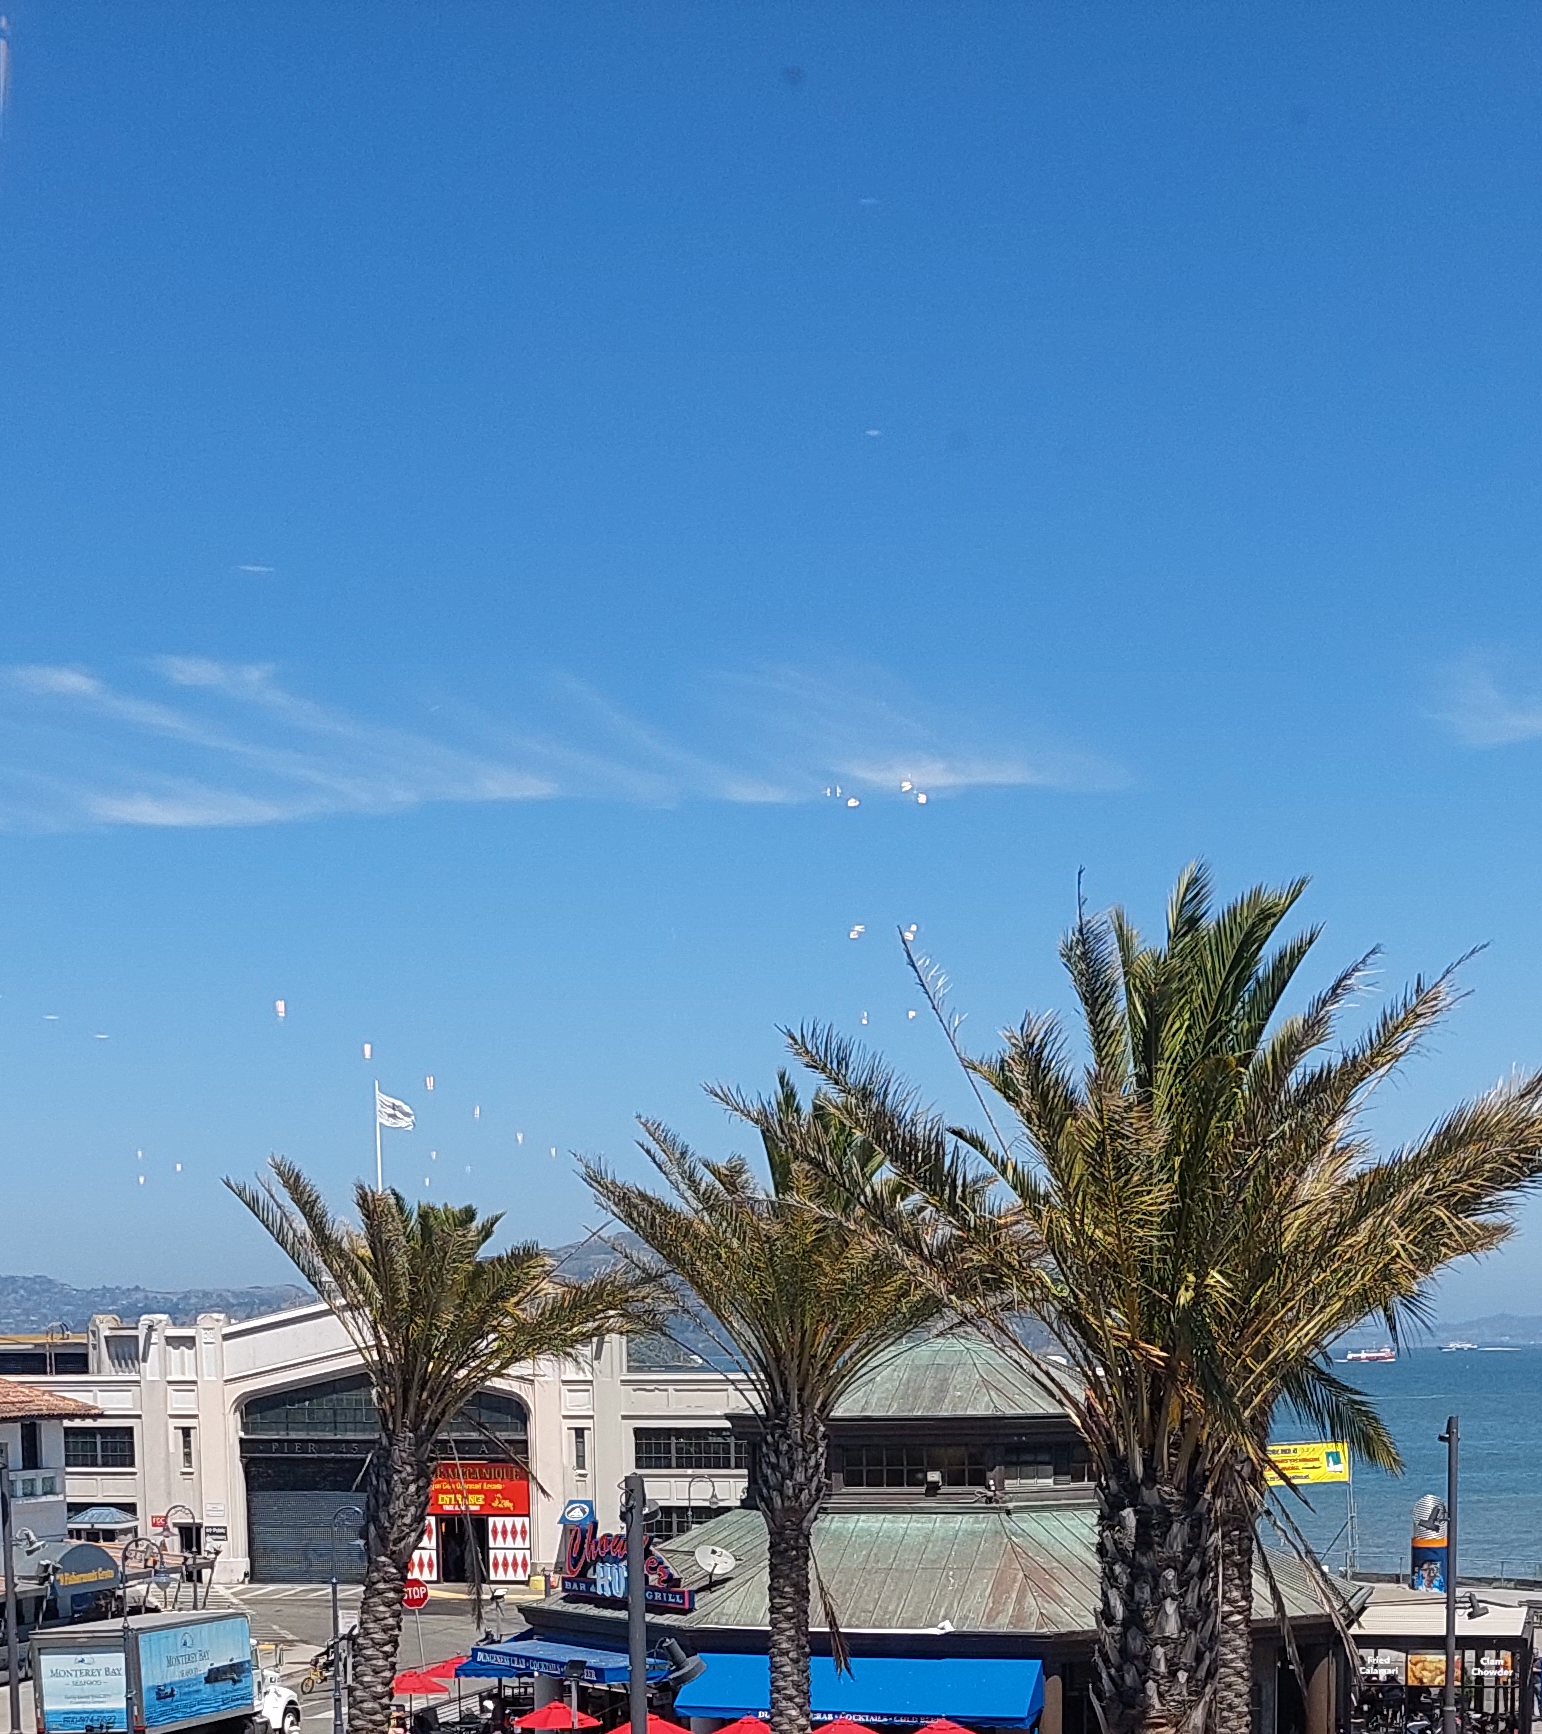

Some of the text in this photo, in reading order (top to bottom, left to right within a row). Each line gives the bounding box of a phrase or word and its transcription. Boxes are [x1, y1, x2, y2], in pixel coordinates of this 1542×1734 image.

[272, 1442, 360, 1454] PIER 45
[564, 1580, 588, 1592] BAR
[645, 1590, 684, 1604] GRILL
[1367, 1655, 1391, 1665] Fried
[1480, 1656, 1504, 1666] Clam
[50, 1667, 122, 1678] MONTEREY BAY
[1359, 1666, 1399, 1676] Calamari
[1470, 1667, 1514, 1677] Chowder
